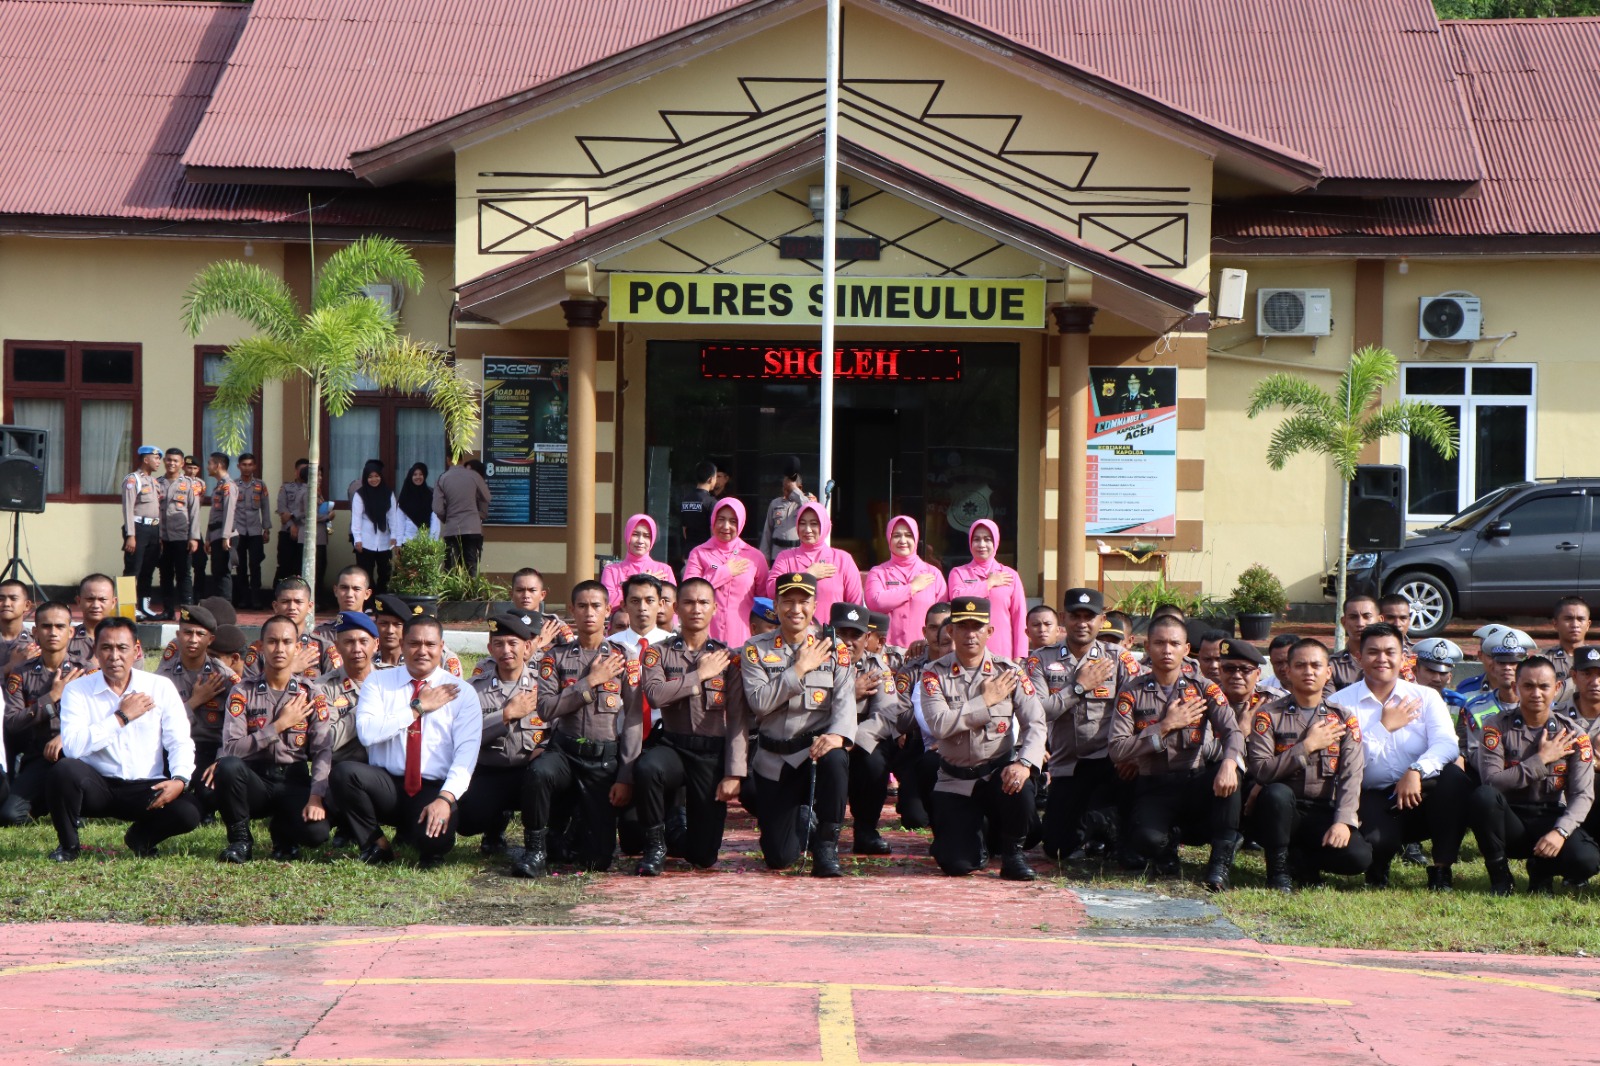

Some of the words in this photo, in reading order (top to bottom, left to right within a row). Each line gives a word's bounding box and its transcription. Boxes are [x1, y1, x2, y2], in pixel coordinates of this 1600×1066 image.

[629, 281, 794, 317] POLRES
[808, 283, 1025, 321] SIMEULUE
[486, 364, 541, 375] PRESISI
[1124, 425, 1154, 441] ACEH
[486, 462, 495, 477] 8
